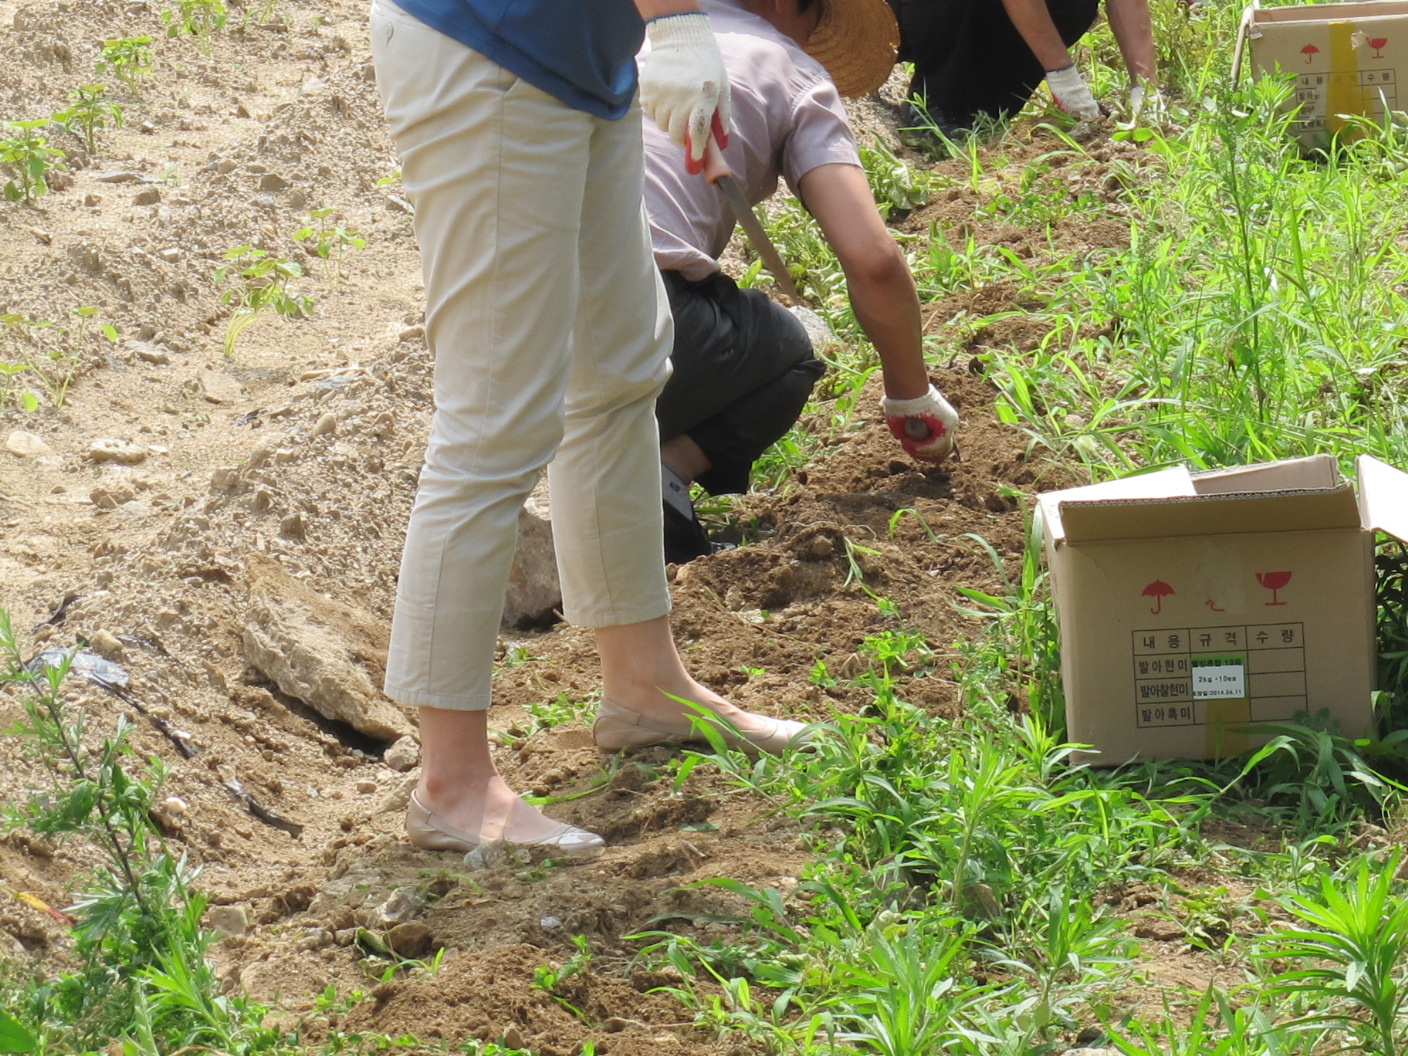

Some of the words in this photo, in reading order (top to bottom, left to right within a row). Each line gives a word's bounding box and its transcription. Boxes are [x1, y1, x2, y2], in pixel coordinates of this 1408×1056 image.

[1139, 659, 1187, 674] 발아현미
[1140, 683, 1188, 698] 발아찰현미
[1142, 706, 1191, 722] 발아흑미
